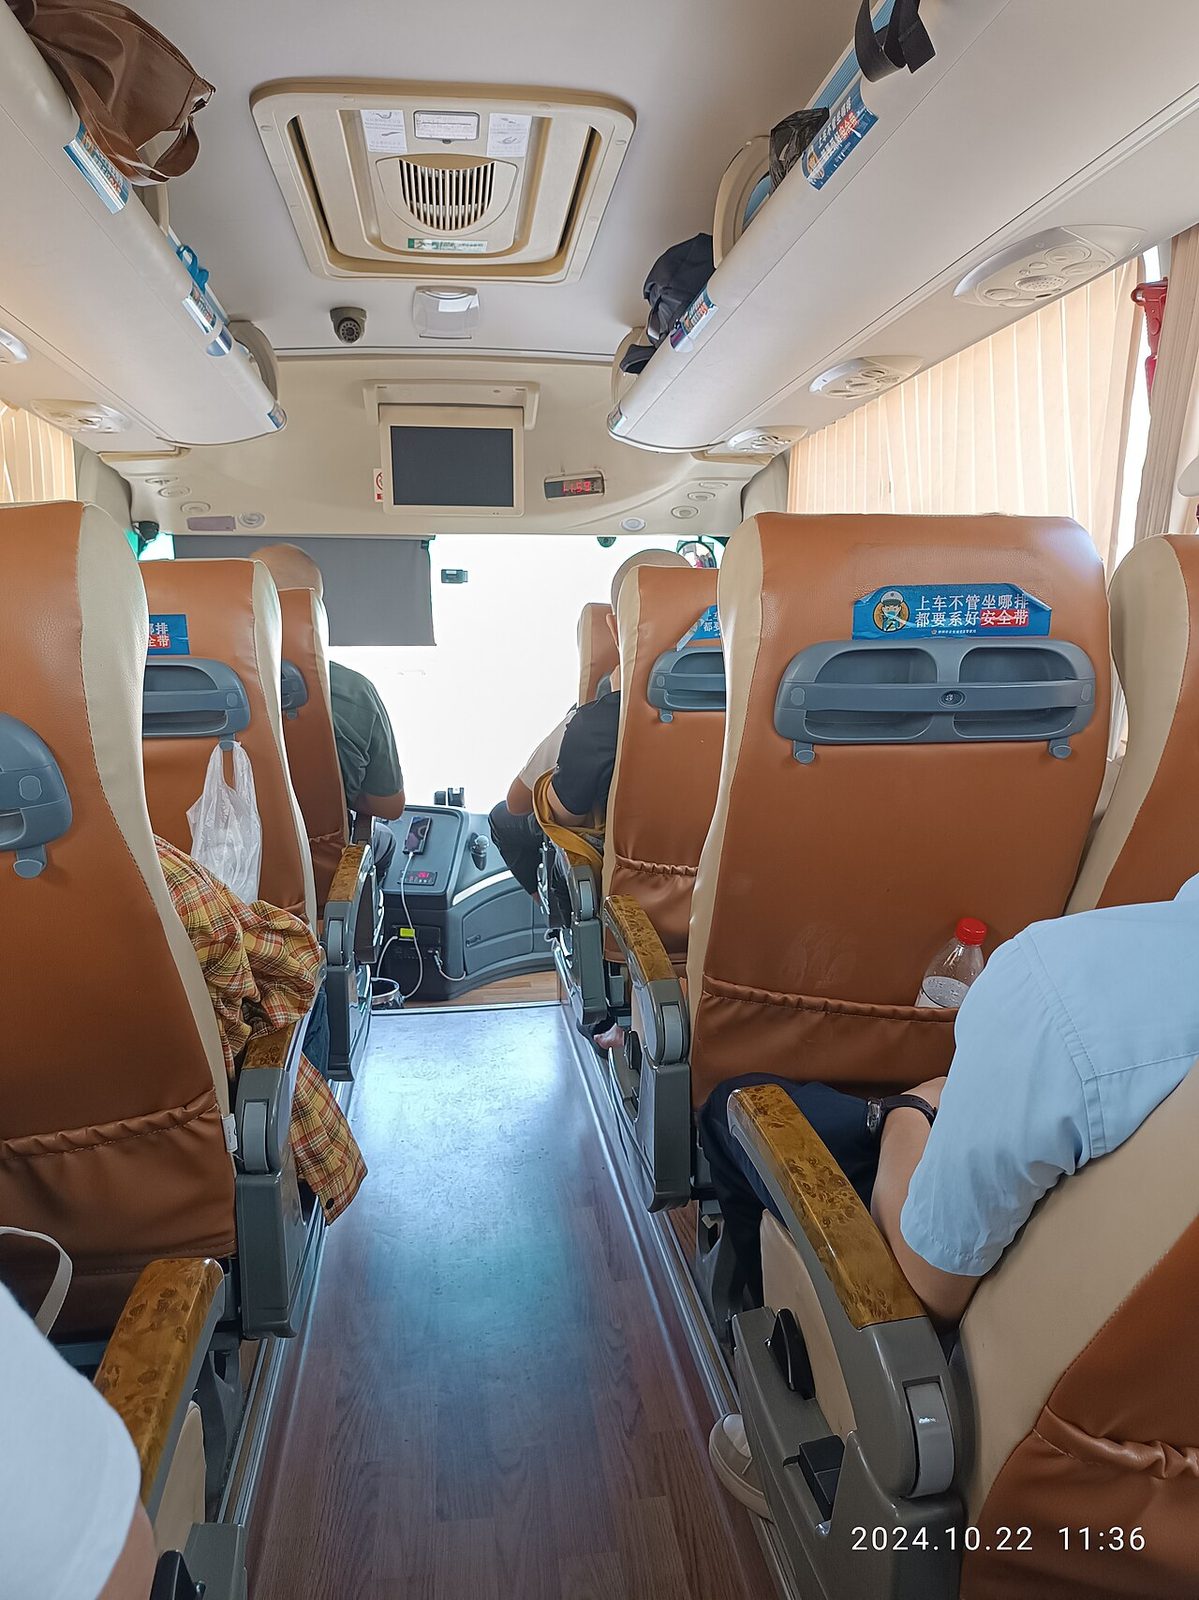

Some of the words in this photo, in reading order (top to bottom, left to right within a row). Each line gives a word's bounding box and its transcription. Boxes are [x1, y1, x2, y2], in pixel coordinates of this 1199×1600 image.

[915, 594, 1029, 611] 上车不管坐哪排
[915, 609, 1029, 627] 都要系好安全带
